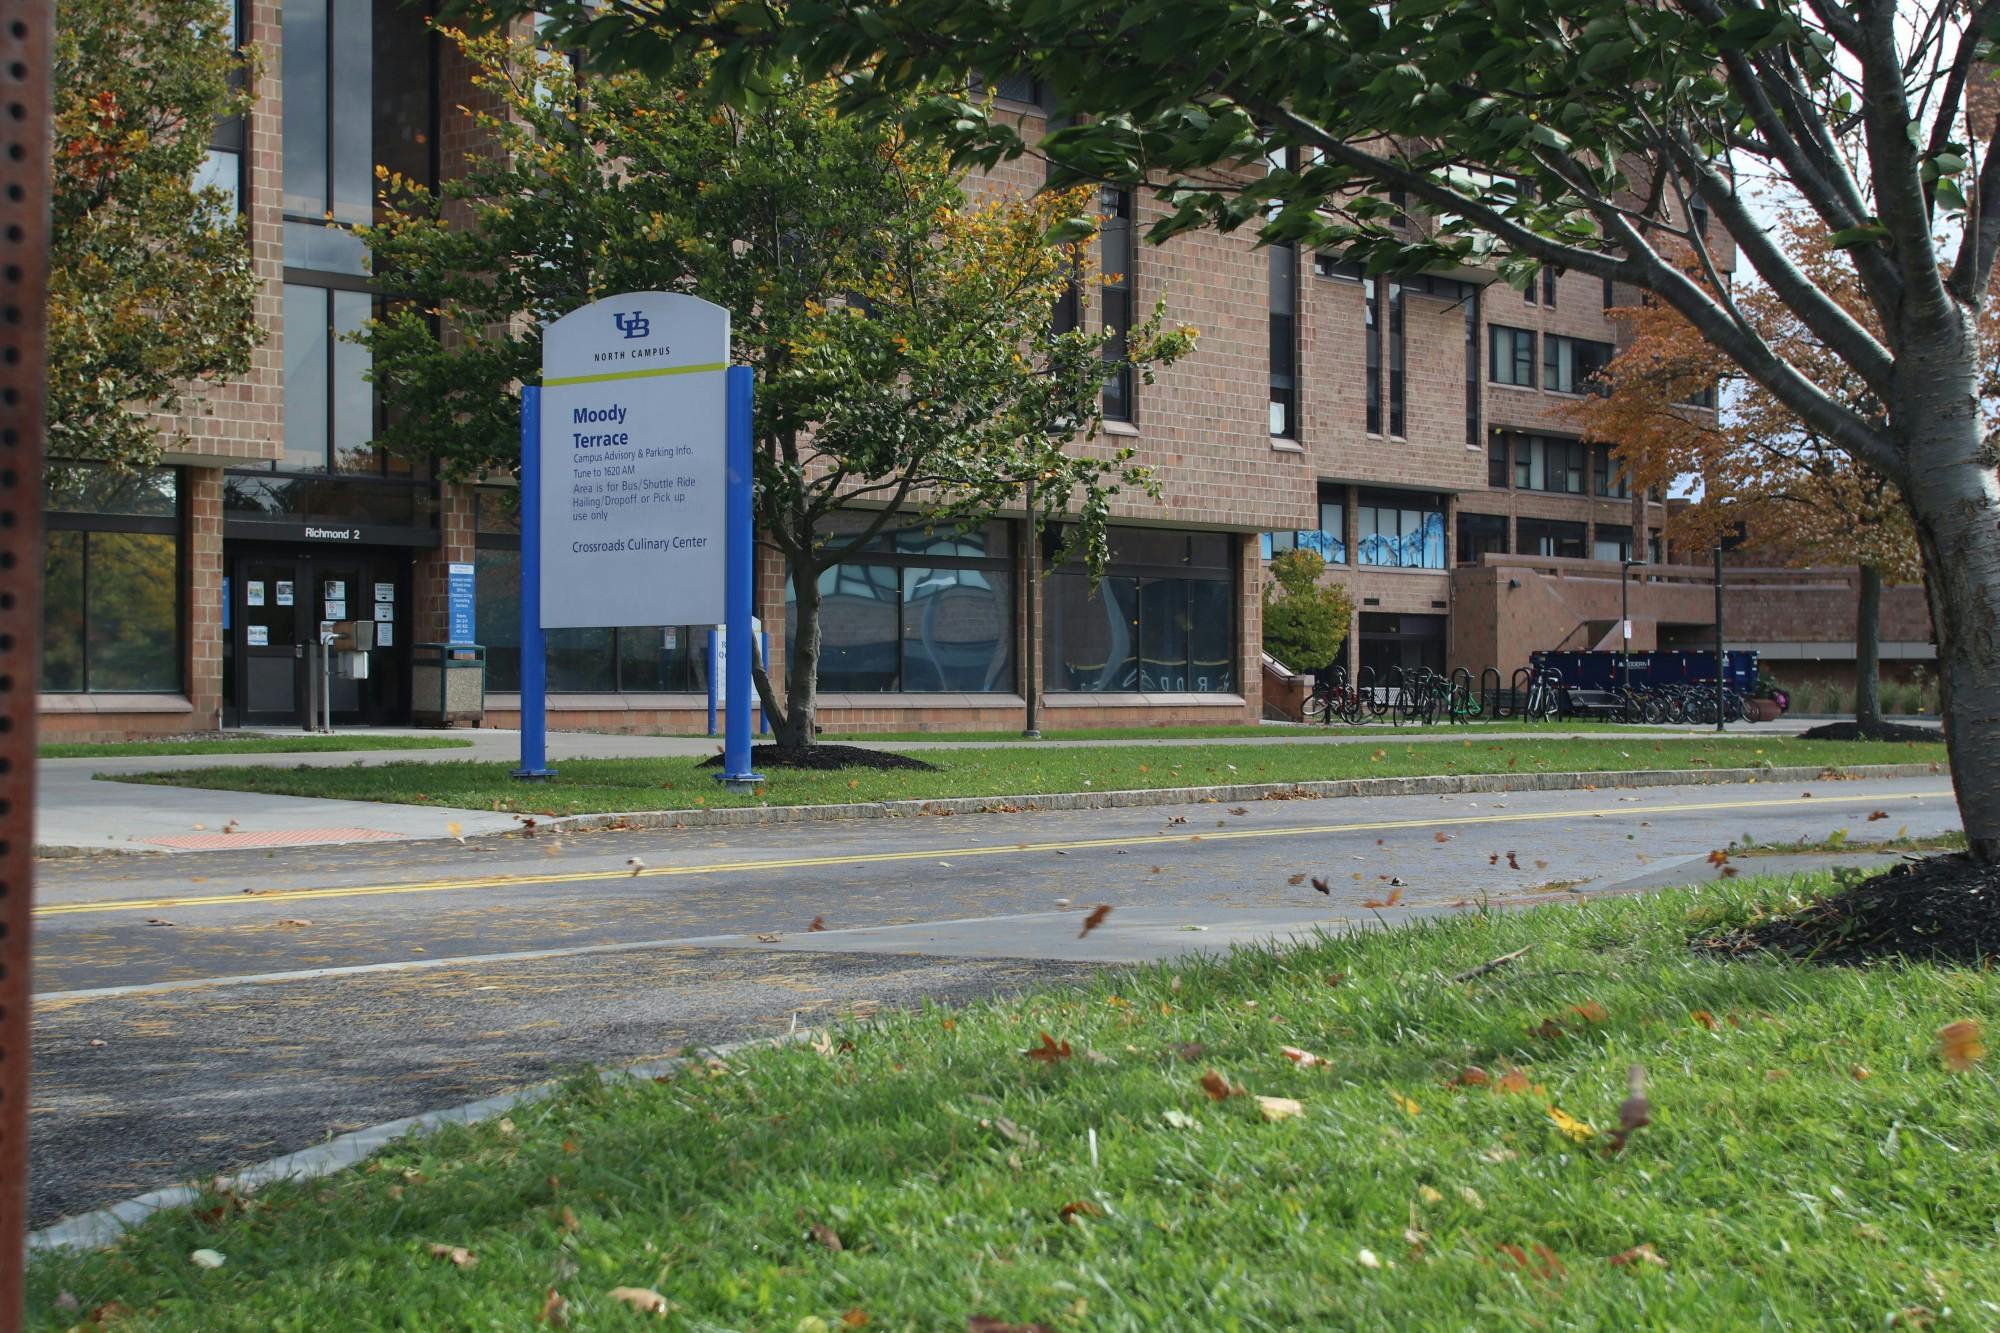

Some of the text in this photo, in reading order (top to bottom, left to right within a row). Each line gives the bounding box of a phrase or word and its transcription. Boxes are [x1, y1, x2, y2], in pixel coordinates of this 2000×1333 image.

[613, 310, 650, 339] UB
[594, 346, 671, 362] NORTH CAMPUS
[573, 403, 627, 425] Moody
[573, 432, 629, 449] Terrace
[573, 445, 694, 464] Campus Advisory & Parking Info.
[573, 465, 636, 479] Tune to 1620 AM
[573, 477, 696, 493] Area is for Bus/Shuttle Ride
[573, 491, 685, 508] Hailing/Dropoff or Pick up
[573, 510, 608, 521] use only
[305, 527, 360, 539] Richmond 2
[572, 536, 708, 553] Crossroads Culinary Center
